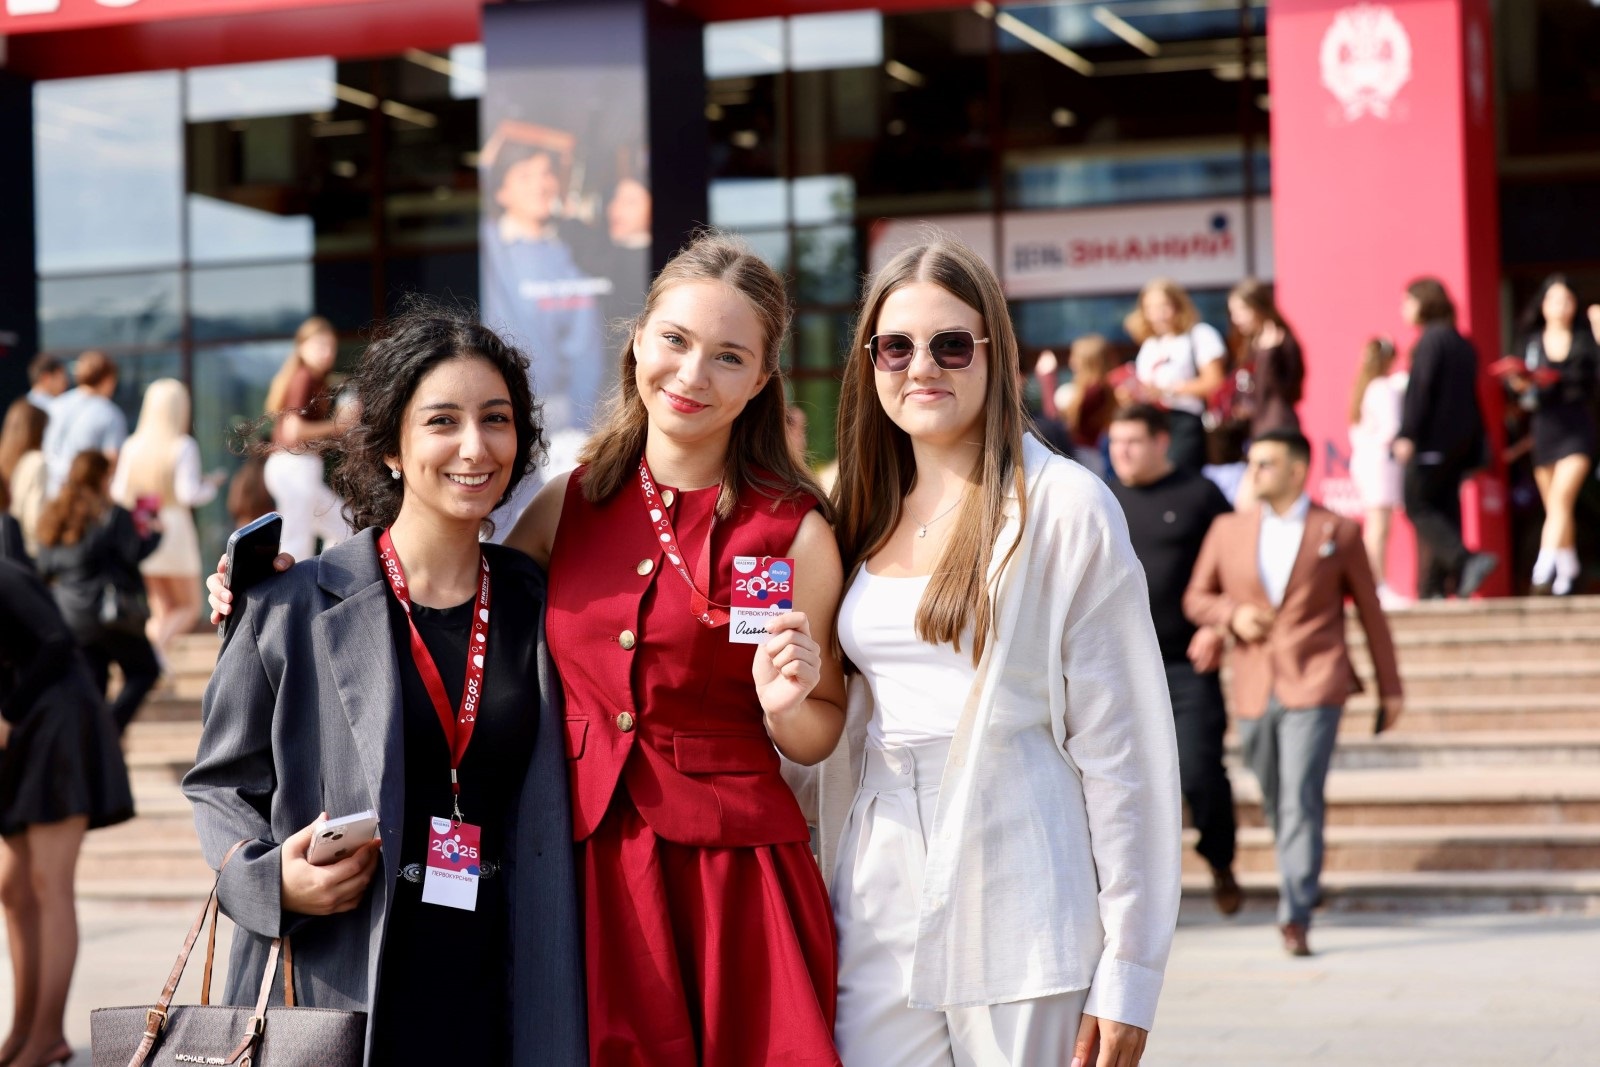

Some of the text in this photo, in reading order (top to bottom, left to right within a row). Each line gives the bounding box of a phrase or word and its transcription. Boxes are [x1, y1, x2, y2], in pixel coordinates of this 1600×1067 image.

[640, 467, 655, 498] 2025
[385, 559, 405, 588] 2025
[735, 577, 790, 597] 2025
[464, 678, 479, 712] 2025
[432, 838, 478, 859] 2025
[431, 869, 474, 883] ПЕРВОКУРСНИК
[175, 1053, 226, 1067] MICHAEL KORS
